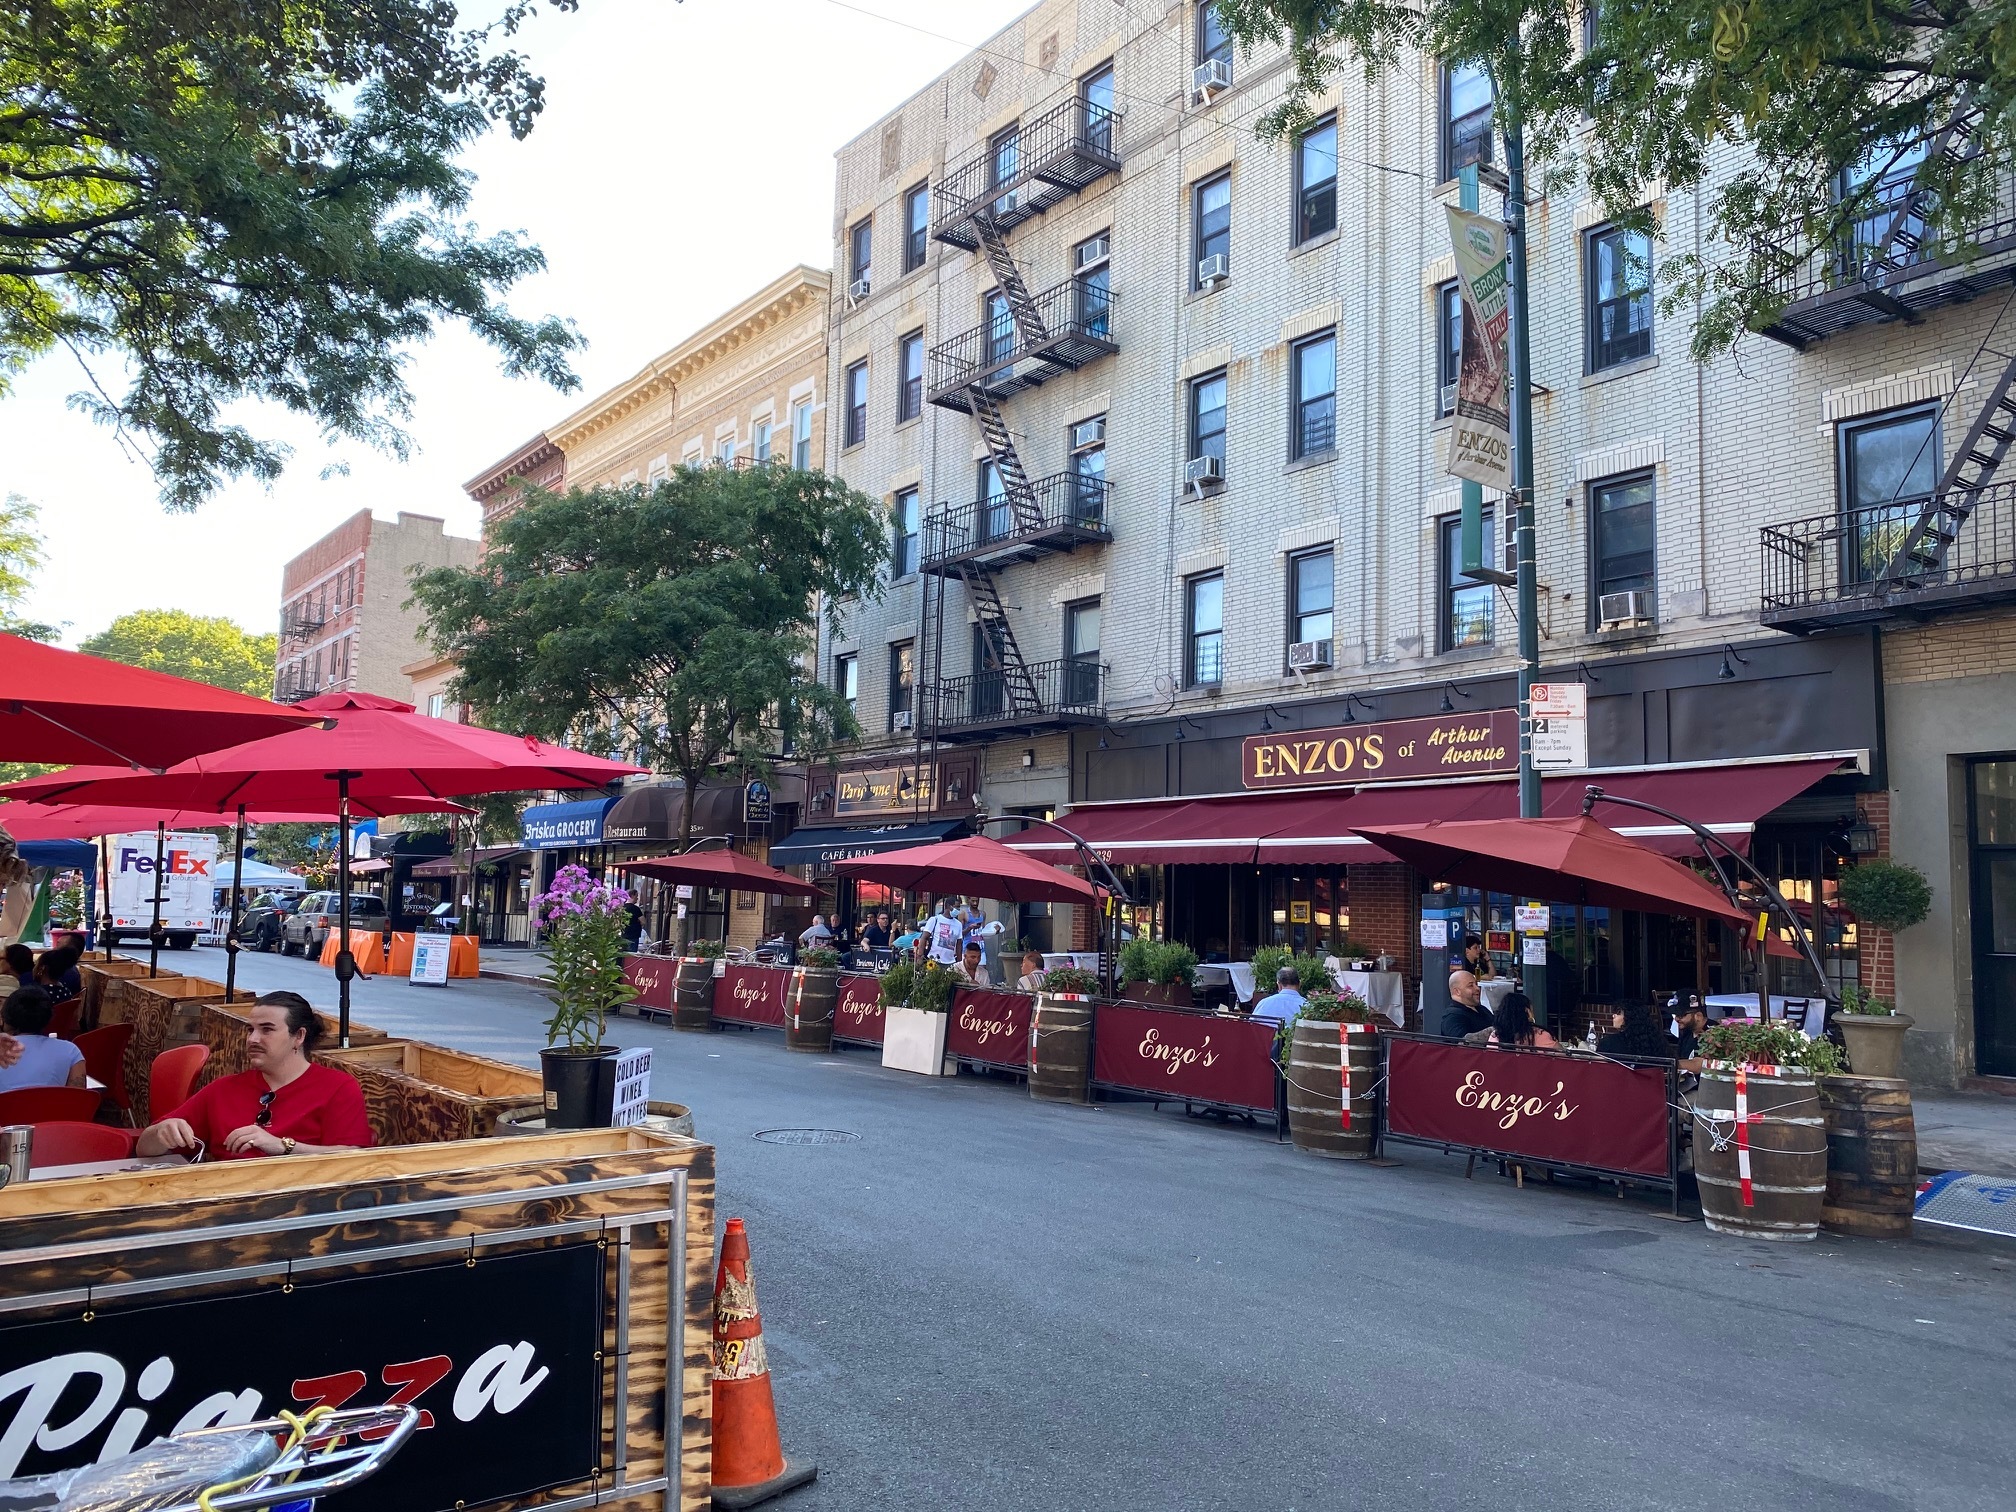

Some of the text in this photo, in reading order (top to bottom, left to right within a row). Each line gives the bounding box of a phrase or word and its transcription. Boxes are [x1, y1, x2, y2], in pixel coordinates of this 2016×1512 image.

[1473, 267, 1504, 299] BRONX
[1481, 288, 1507, 319] LITTLE
[1488, 312, 1507, 341] ITALY
[1457, 429, 1508, 461] ENZO'S
[1462, 452, 1487, 465] Arthur
[1486, 457, 1506, 472] Avenue
[1426, 725, 1491, 746] Arthur
[1536, 720, 1544, 732] 2
[1254, 734, 1415, 778] ENZO'S of
[1441, 746, 1505, 764] Avenue
[525, 818, 554, 840] Briska
[557, 819, 597, 838] GROCERY
[607, 825, 648, 837] Restaurant
[120, 847, 209, 874] FedEx
[821, 848, 874, 860] CAFÉ & BAR
[1452, 921, 1460, 938] P
[634, 967, 659, 995] Enzo's
[733, 977, 770, 1008] Enzo's
[842, 990, 883, 1025] Enzo's
[960, 1004, 1017, 1044] Enzo's
[1138, 1028, 1220, 1075] Enzo's
[617, 1054, 651, 1082] COLD BEER
[627, 1101, 647, 1124] BITES
[1455, 1070, 1580, 1130] Enzo's
[0, 1340, 550, 1481] Piazza
